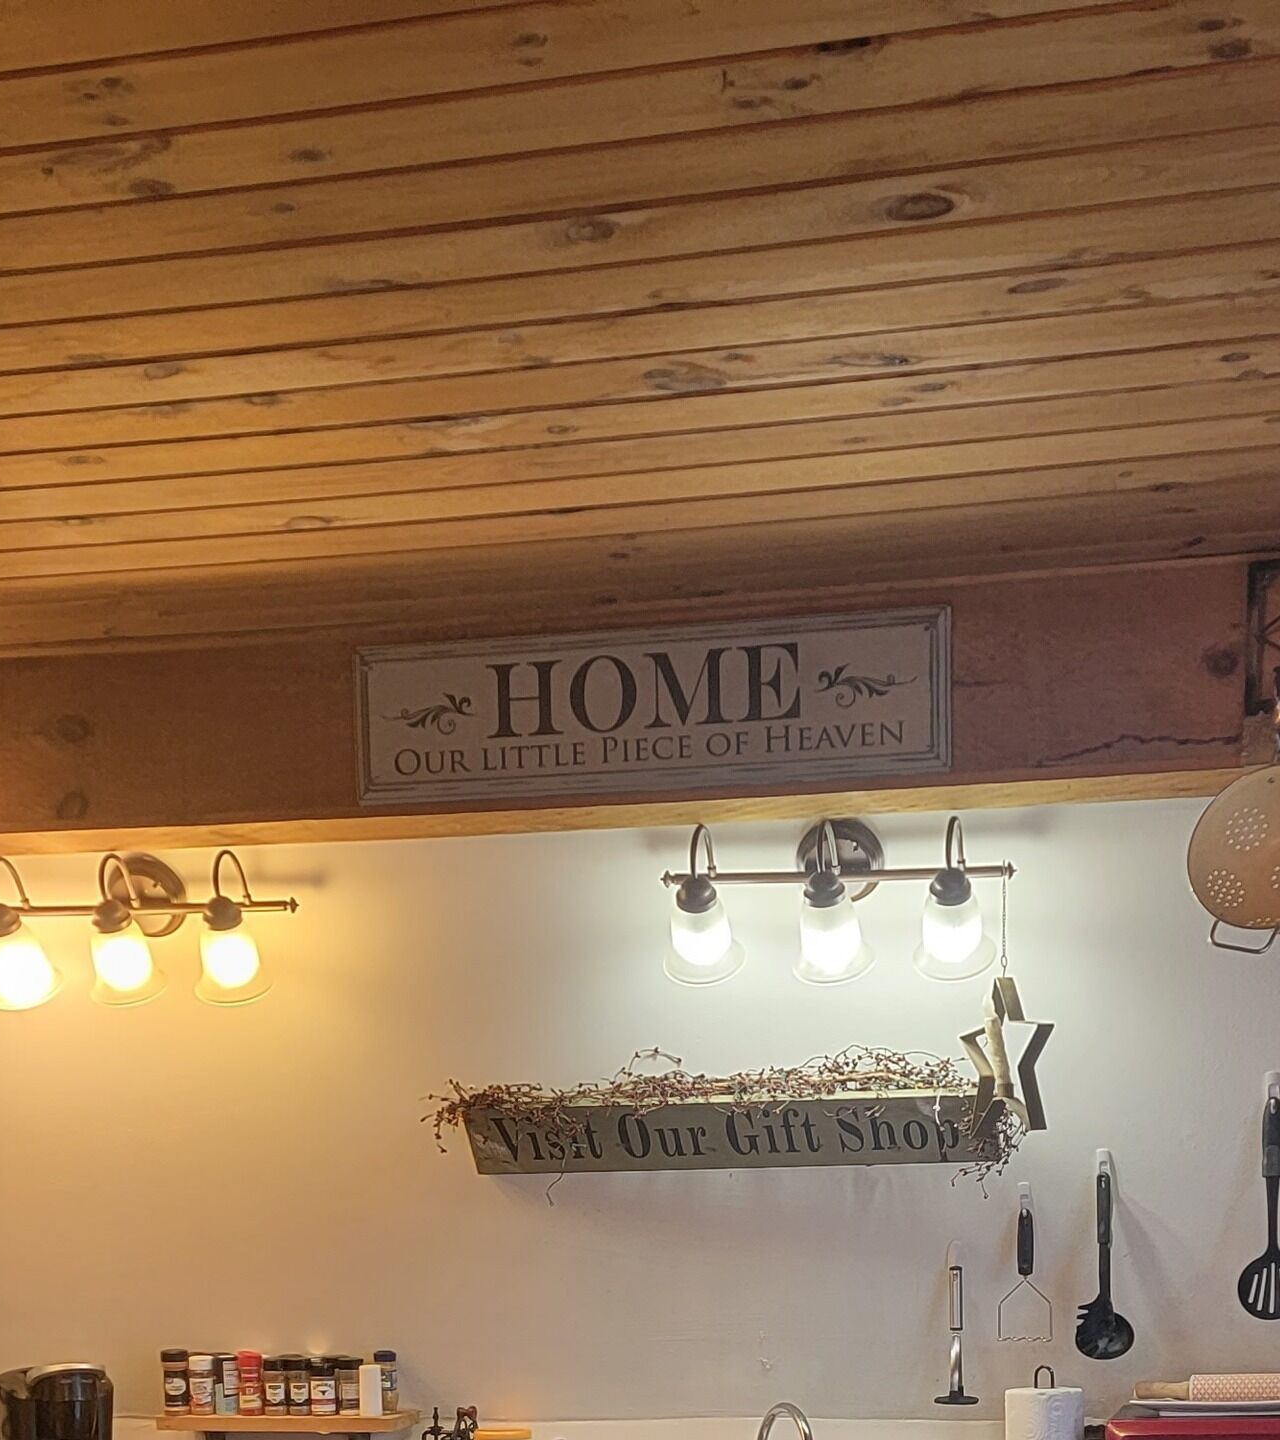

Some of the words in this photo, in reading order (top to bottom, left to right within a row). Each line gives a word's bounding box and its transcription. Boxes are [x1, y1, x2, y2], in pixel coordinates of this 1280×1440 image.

[485, 642, 802, 739] HOME
[394, 747, 471, 777] OUR
[482, 742, 586, 771] LITTLE
[601, 734, 692, 765] PIECE
[765, 719, 905, 755] HEAVEN
[490, 1114, 604, 1164] Visit
[616, 1113, 709, 1159] Our
[725, 1109, 821, 1156] Gift
[837, 1106, 961, 1163] Shop
